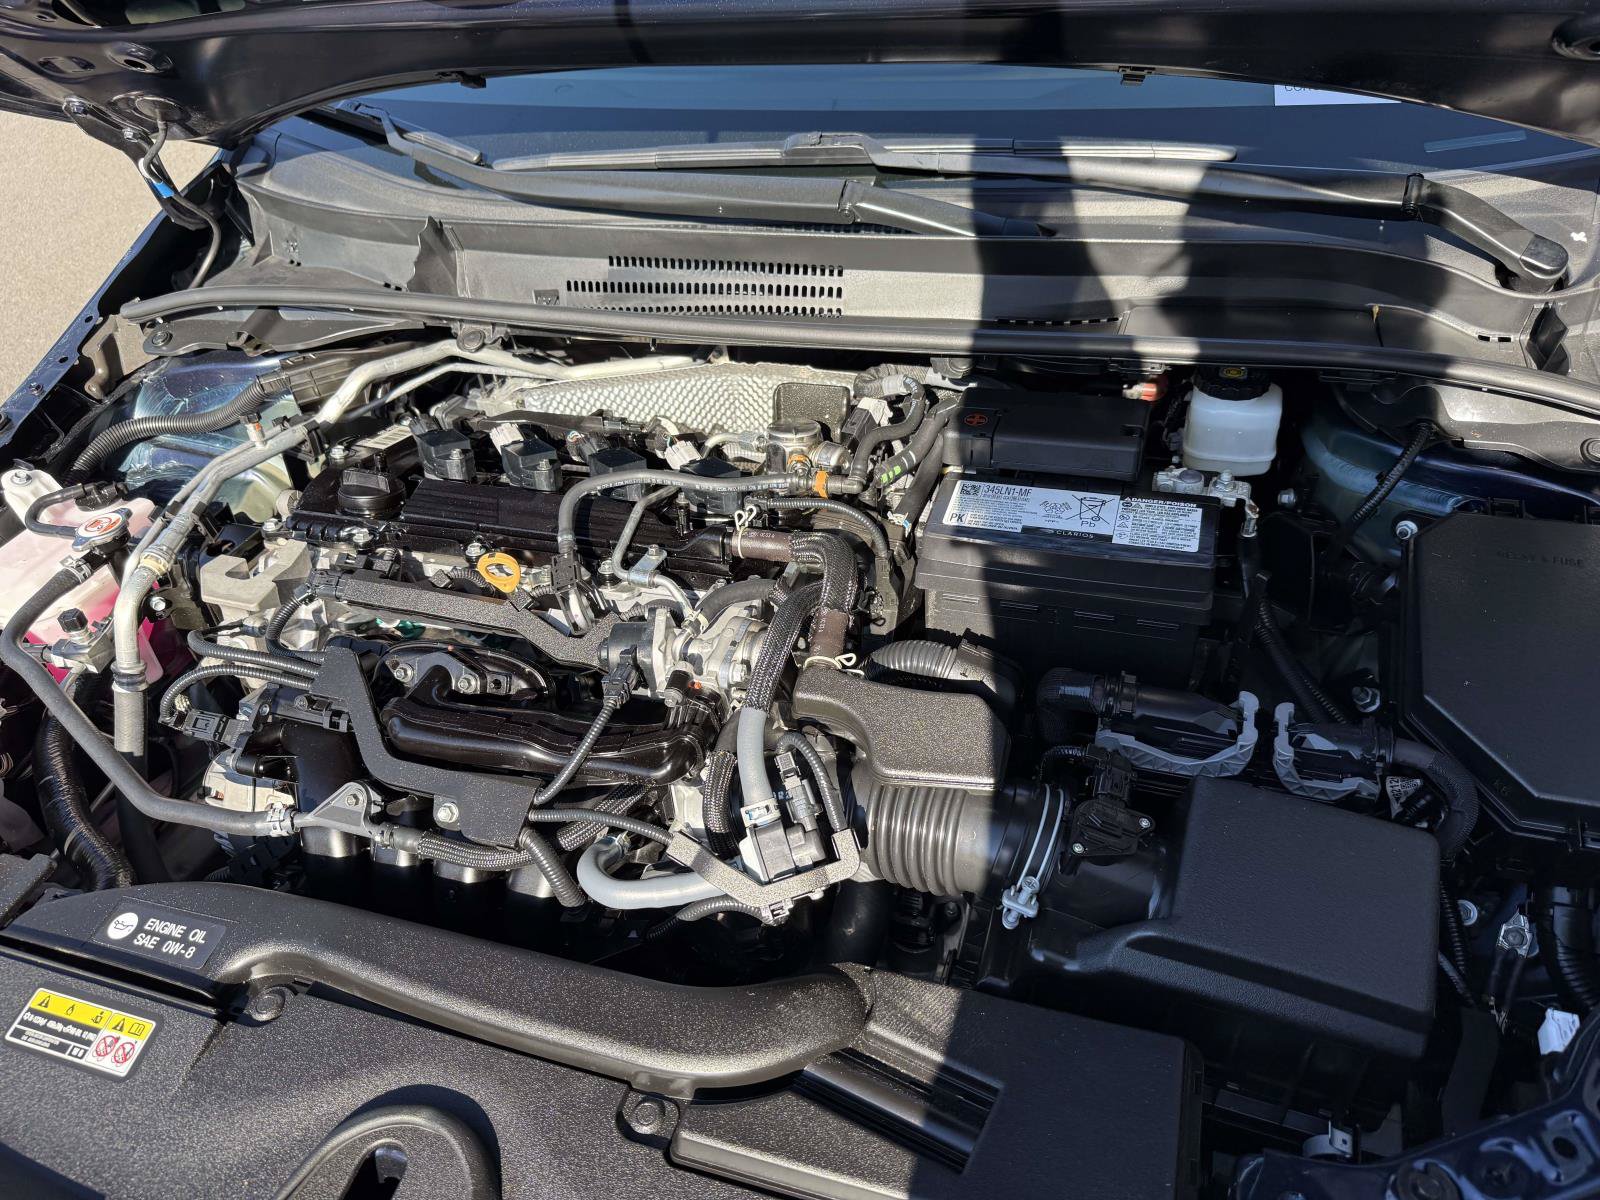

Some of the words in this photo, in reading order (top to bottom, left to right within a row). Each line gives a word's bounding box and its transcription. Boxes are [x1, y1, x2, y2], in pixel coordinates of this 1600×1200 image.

[984, 484, 1032, 497] 345LN1-MF
[949, 512, 965, 523] PK
[1081, 520, 1096, 528] Pb
[1057, 531, 1095, 539] CLARIOS
[144, 918, 187, 937] ENGINE
[189, 929, 207, 944] OIL
[133, 933, 160, 948] SAE
[162, 941, 196, 958] 0W-8
